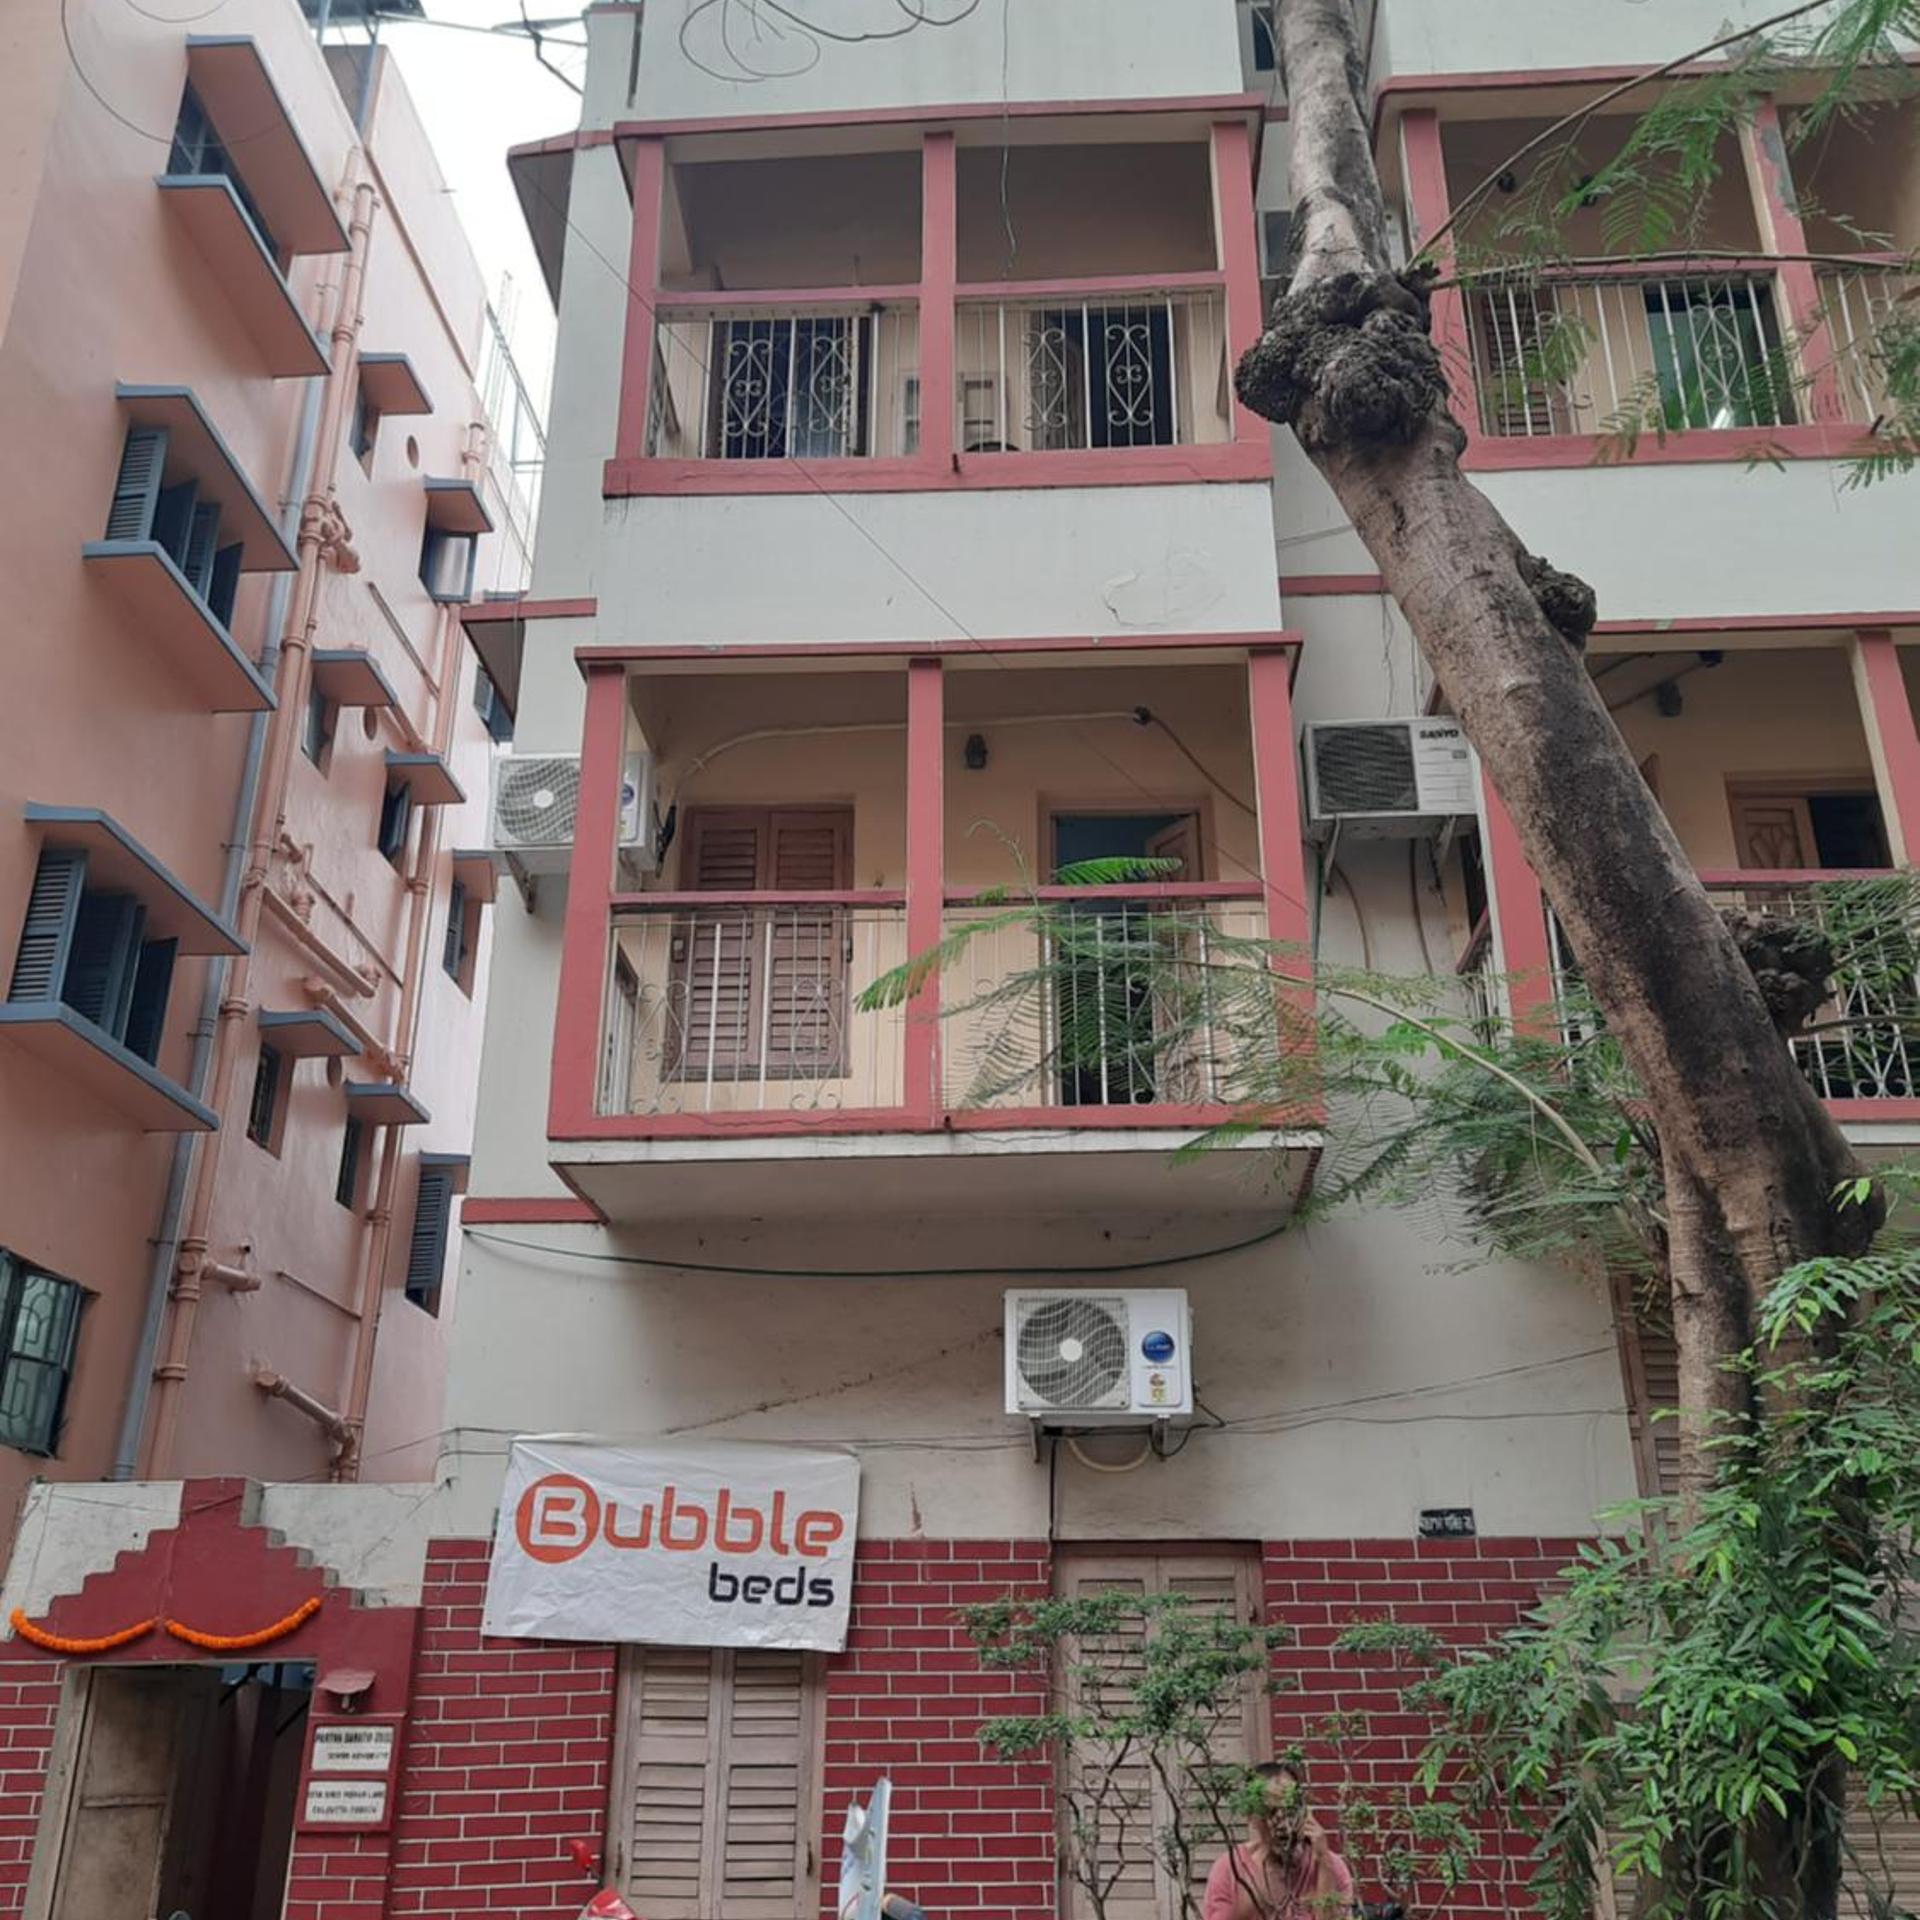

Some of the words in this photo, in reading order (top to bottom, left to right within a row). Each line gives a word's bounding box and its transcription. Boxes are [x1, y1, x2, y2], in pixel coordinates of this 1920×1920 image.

[1419, 728, 1459, 740] SANYO
[515, 1472, 845, 1564] Bubble
[709, 1562, 835, 1607] beds
